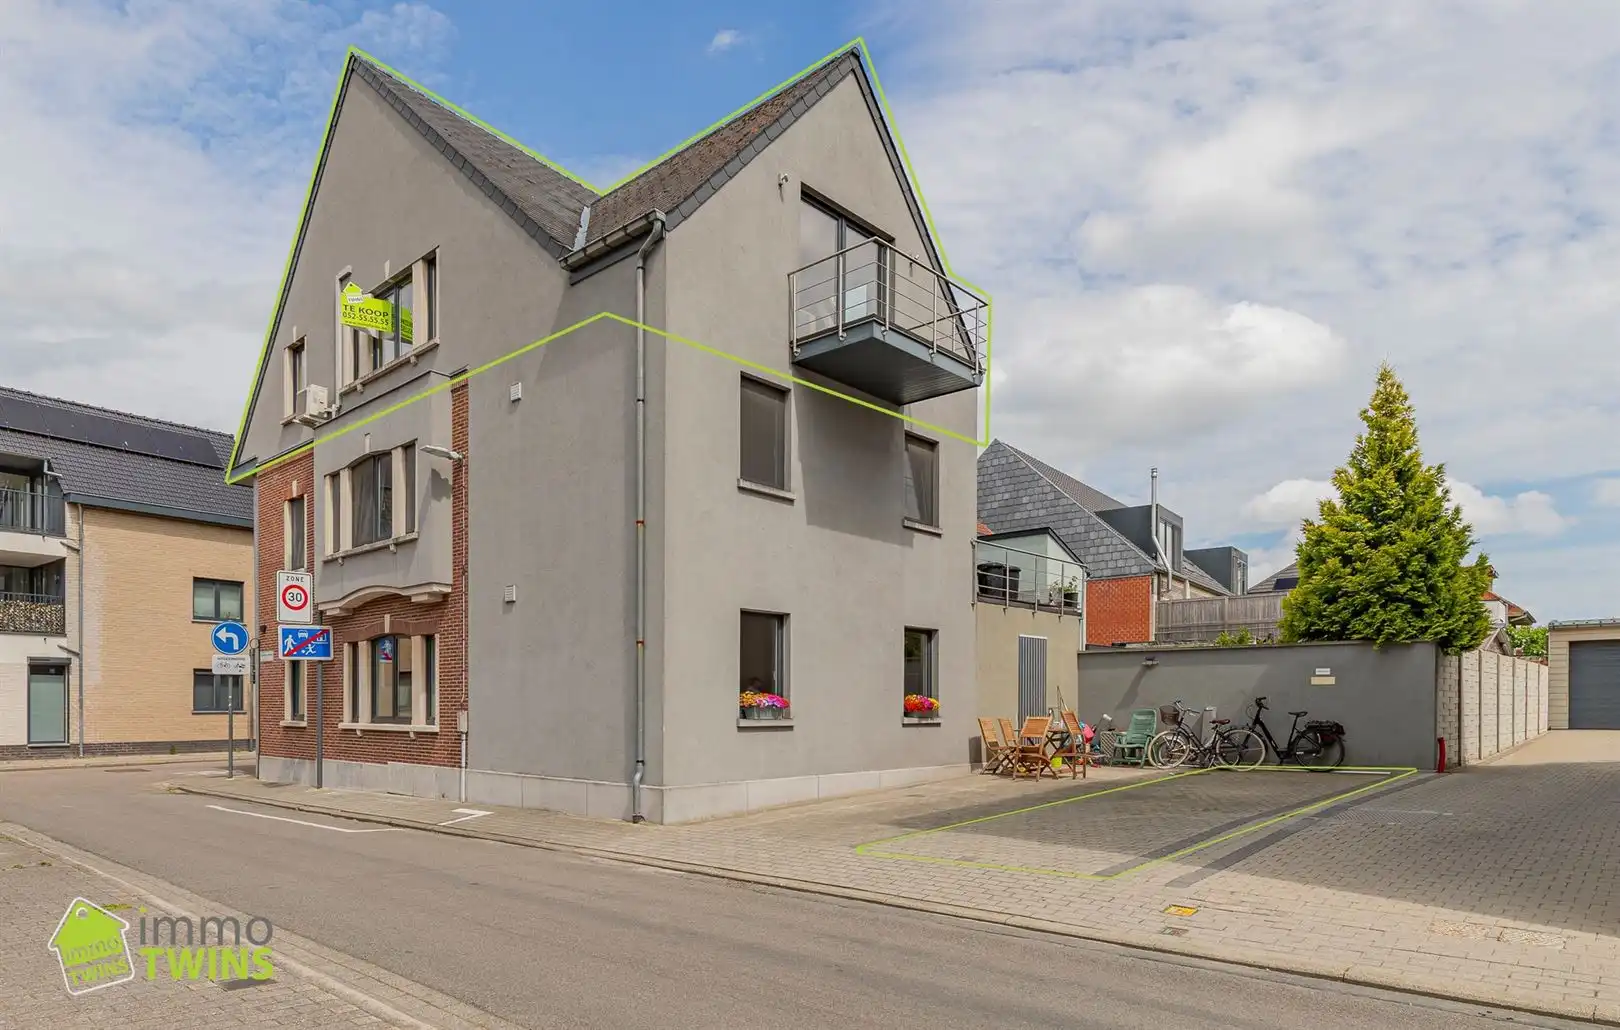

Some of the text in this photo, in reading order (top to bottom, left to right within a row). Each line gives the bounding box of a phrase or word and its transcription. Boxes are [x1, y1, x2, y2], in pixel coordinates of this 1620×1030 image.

[342, 311, 389, 325] 052-55.55.55
[343, 304, 389, 318] TE KOOP
[288, 592, 302, 602] 30
